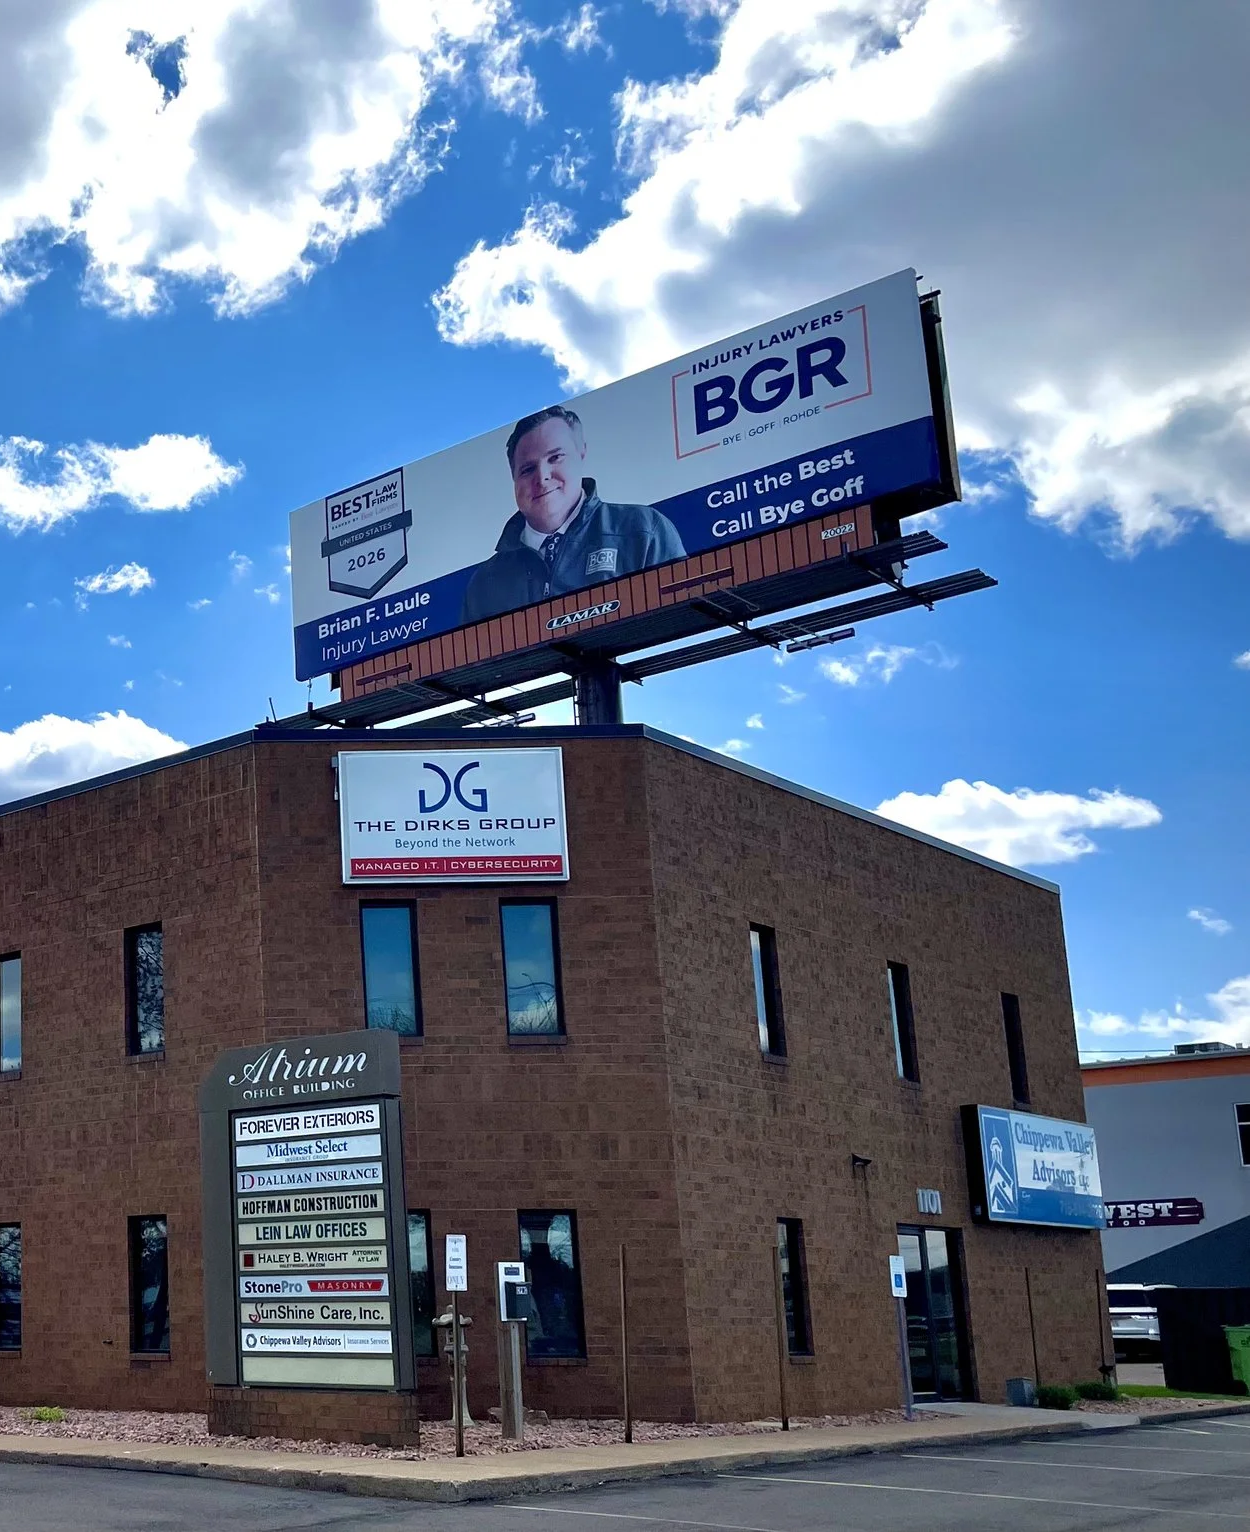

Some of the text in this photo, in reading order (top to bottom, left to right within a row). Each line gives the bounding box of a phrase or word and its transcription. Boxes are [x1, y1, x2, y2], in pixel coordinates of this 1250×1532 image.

[693, 310, 843, 375] INJURY LAWYERS
[694, 336, 849, 435] BGR
[723, 406, 821, 446] BYE GOFF ROHDE
[375, 481, 398, 496] LAW
[707, 449, 855, 508] Call the Best
[331, 491, 373, 522] BEST
[372, 491, 397, 506] FIRMS
[712, 475, 864, 538] Call Bye Goff
[340, 533, 364, 546] UNITED
[366, 522, 392, 537] STATES
[824, 524, 852, 538] 20022
[348, 548, 386, 572] 2026
[590, 551, 613, 566] BGR
[318, 592, 430, 639] Brian F. Laule
[552, 603, 613, 627] LAMAR
[322, 617, 428, 661] Injury Lawyer
[354, 818, 556, 832] THE DIRKS GROUP
[395, 836, 515, 850] Beyond the Network
[355, 859, 558, 871] MANAGED I.T. CYBERSECURITY
[229, 1047, 368, 1086] Atrium
[243, 1078, 355, 1100] OFFICE BUILDING
[240, 1110, 374, 1135] FOREVER EXTERIORS
[267, 1140, 348, 1158] Midwest Select
[1015, 1122, 1094, 1160] Chippewa Valley
[258, 1173, 312, 1186] DALLMAN
[316, 1168, 379, 1182] INSURANCE
[1032, 1159, 1076, 1186] Advisors
[242, 1194, 378, 1215] HOFFMAN CONSTRUCTION
[916, 1187, 942, 1214] 1101
[256, 1222, 367, 1240] LEIN LAW OFFICES
[258, 1252, 348, 1264] HALEY B. WRIGHT
[244, 1280, 373, 1294] StonePro MASONRY
[249, 1302, 384, 1323] SunShine Care, Inc.
[260, 1335, 290, 1346] Chippewa
[292, 1336, 311, 1348] Valley
[313, 1336, 341, 1346] Advisors
